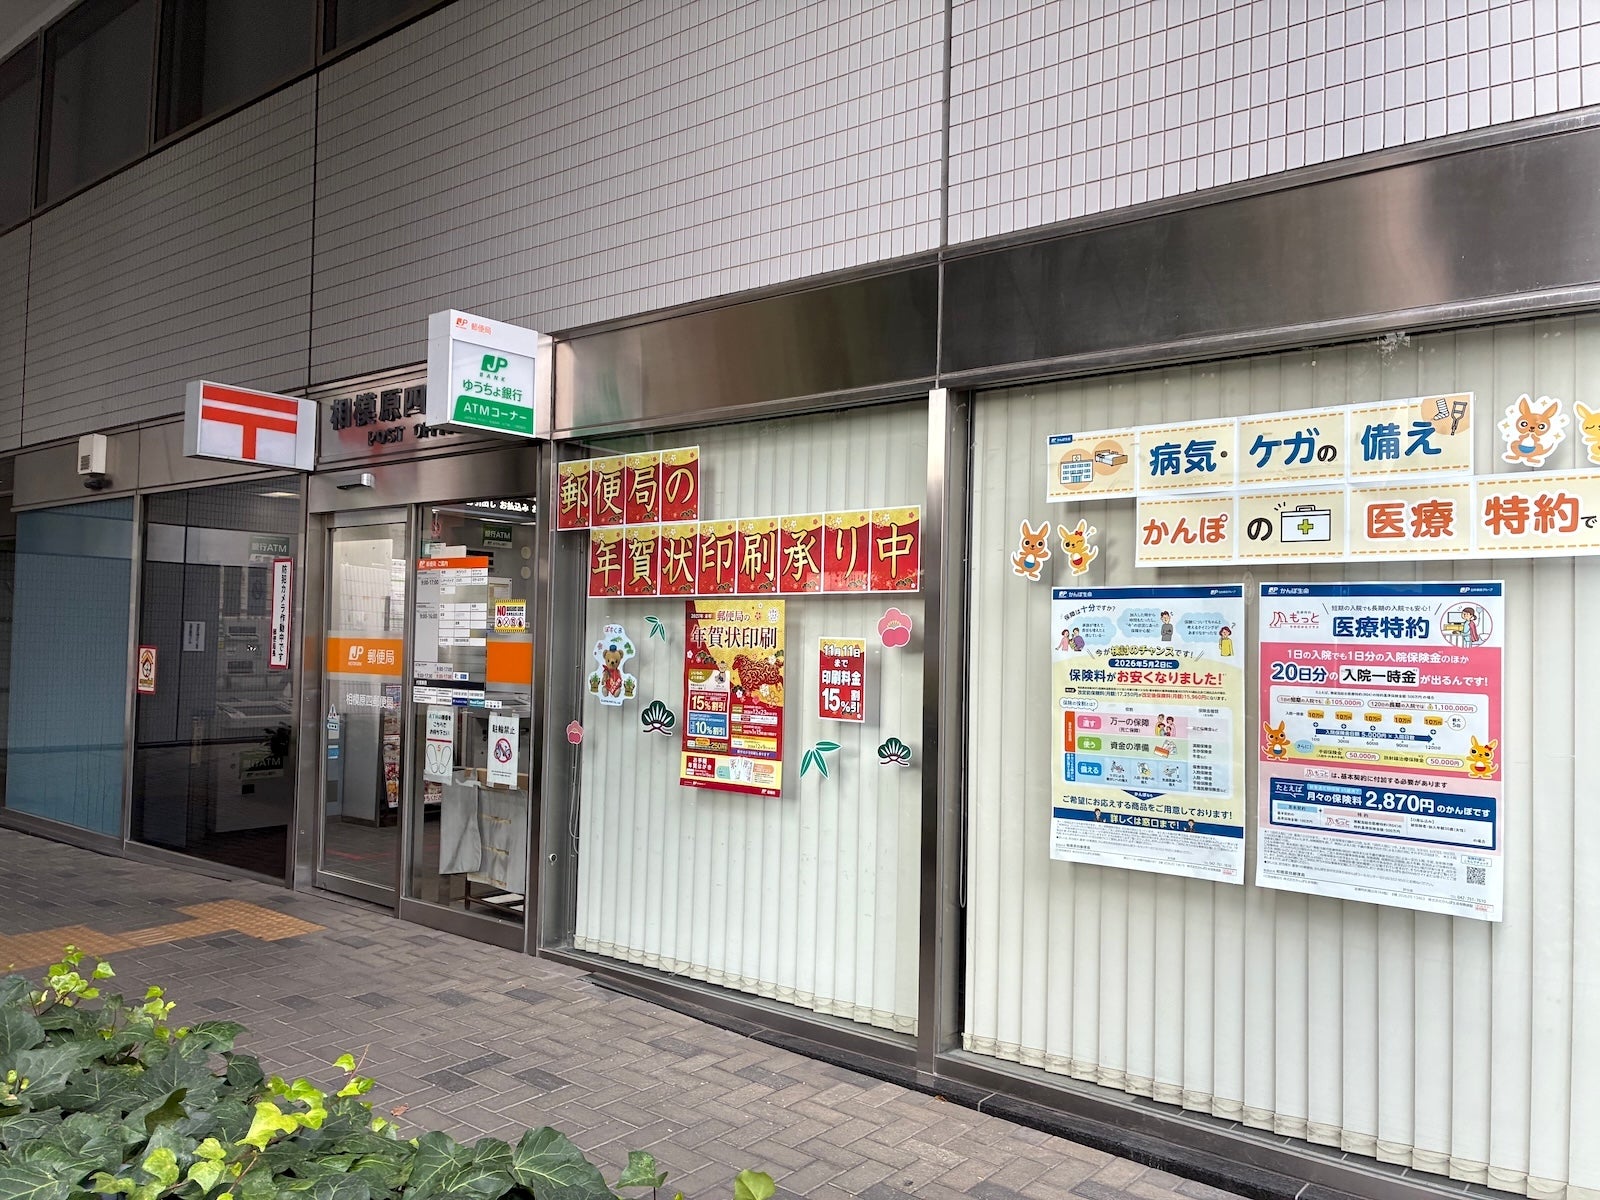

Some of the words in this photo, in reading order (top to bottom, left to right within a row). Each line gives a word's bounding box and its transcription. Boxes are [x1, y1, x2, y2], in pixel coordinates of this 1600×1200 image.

[481, 354, 508, 373] JP
[480, 372, 506, 382] BANK
[462, 379, 523, 402] ゆうちょ銀行
[464, 402, 527, 421] ATMコーナー
[368, 426, 406, 446] POST
[1150, 421, 1442, 476] 病気・ケガの備え
[559, 466, 695, 519] 郵便局の
[1142, 514, 1273, 546] かんぽの
[1366, 492, 1598, 540] 医療特約で
[592, 522, 916, 588] 年賀状印刷承り中
[497, 606, 506, 616] NO
[716, 610, 750, 622] 郵便局の
[1331, 604, 1431, 612] 短期の入院でも長期の入院でも安心!
[1290, 612, 1319, 623] もっと
[1332, 616, 1430, 639] 医療特約
[690, 624, 778, 650] 年賀状印刷
[367, 649, 394, 665] 郵便局
[823, 644, 860, 658] 11月11日
[834, 658, 848, 668] まで
[1114, 660, 1172, 668] 2026年5月2日に
[822, 670, 862, 686] 印刷料金
[1070, 669, 1222, 686] 保険料がお安くなりました!
[692, 694, 726, 712] 15%割引
[492, 724, 516, 735] 駐輪禁止
[695, 721, 726, 736] 10%割引
[1110, 716, 1150, 727] 万一の保障
[1110, 741, 1150, 752] 資金の準備
[1349, 752, 1376, 760] 50,000円
[1430, 758, 1460, 766] 50,000円
[1276, 784, 1302, 793] たとえば
[1062, 794, 1232, 820] ご希望にお応えする商品をご用意しております!
[1307, 791, 1362, 806] 月々の保険料
[1366, 791, 1434, 813] 2,870円
[1437, 805, 1490, 818] のかんぽです
[1110, 814, 1180, 830] 詳しくは窓口まで!
